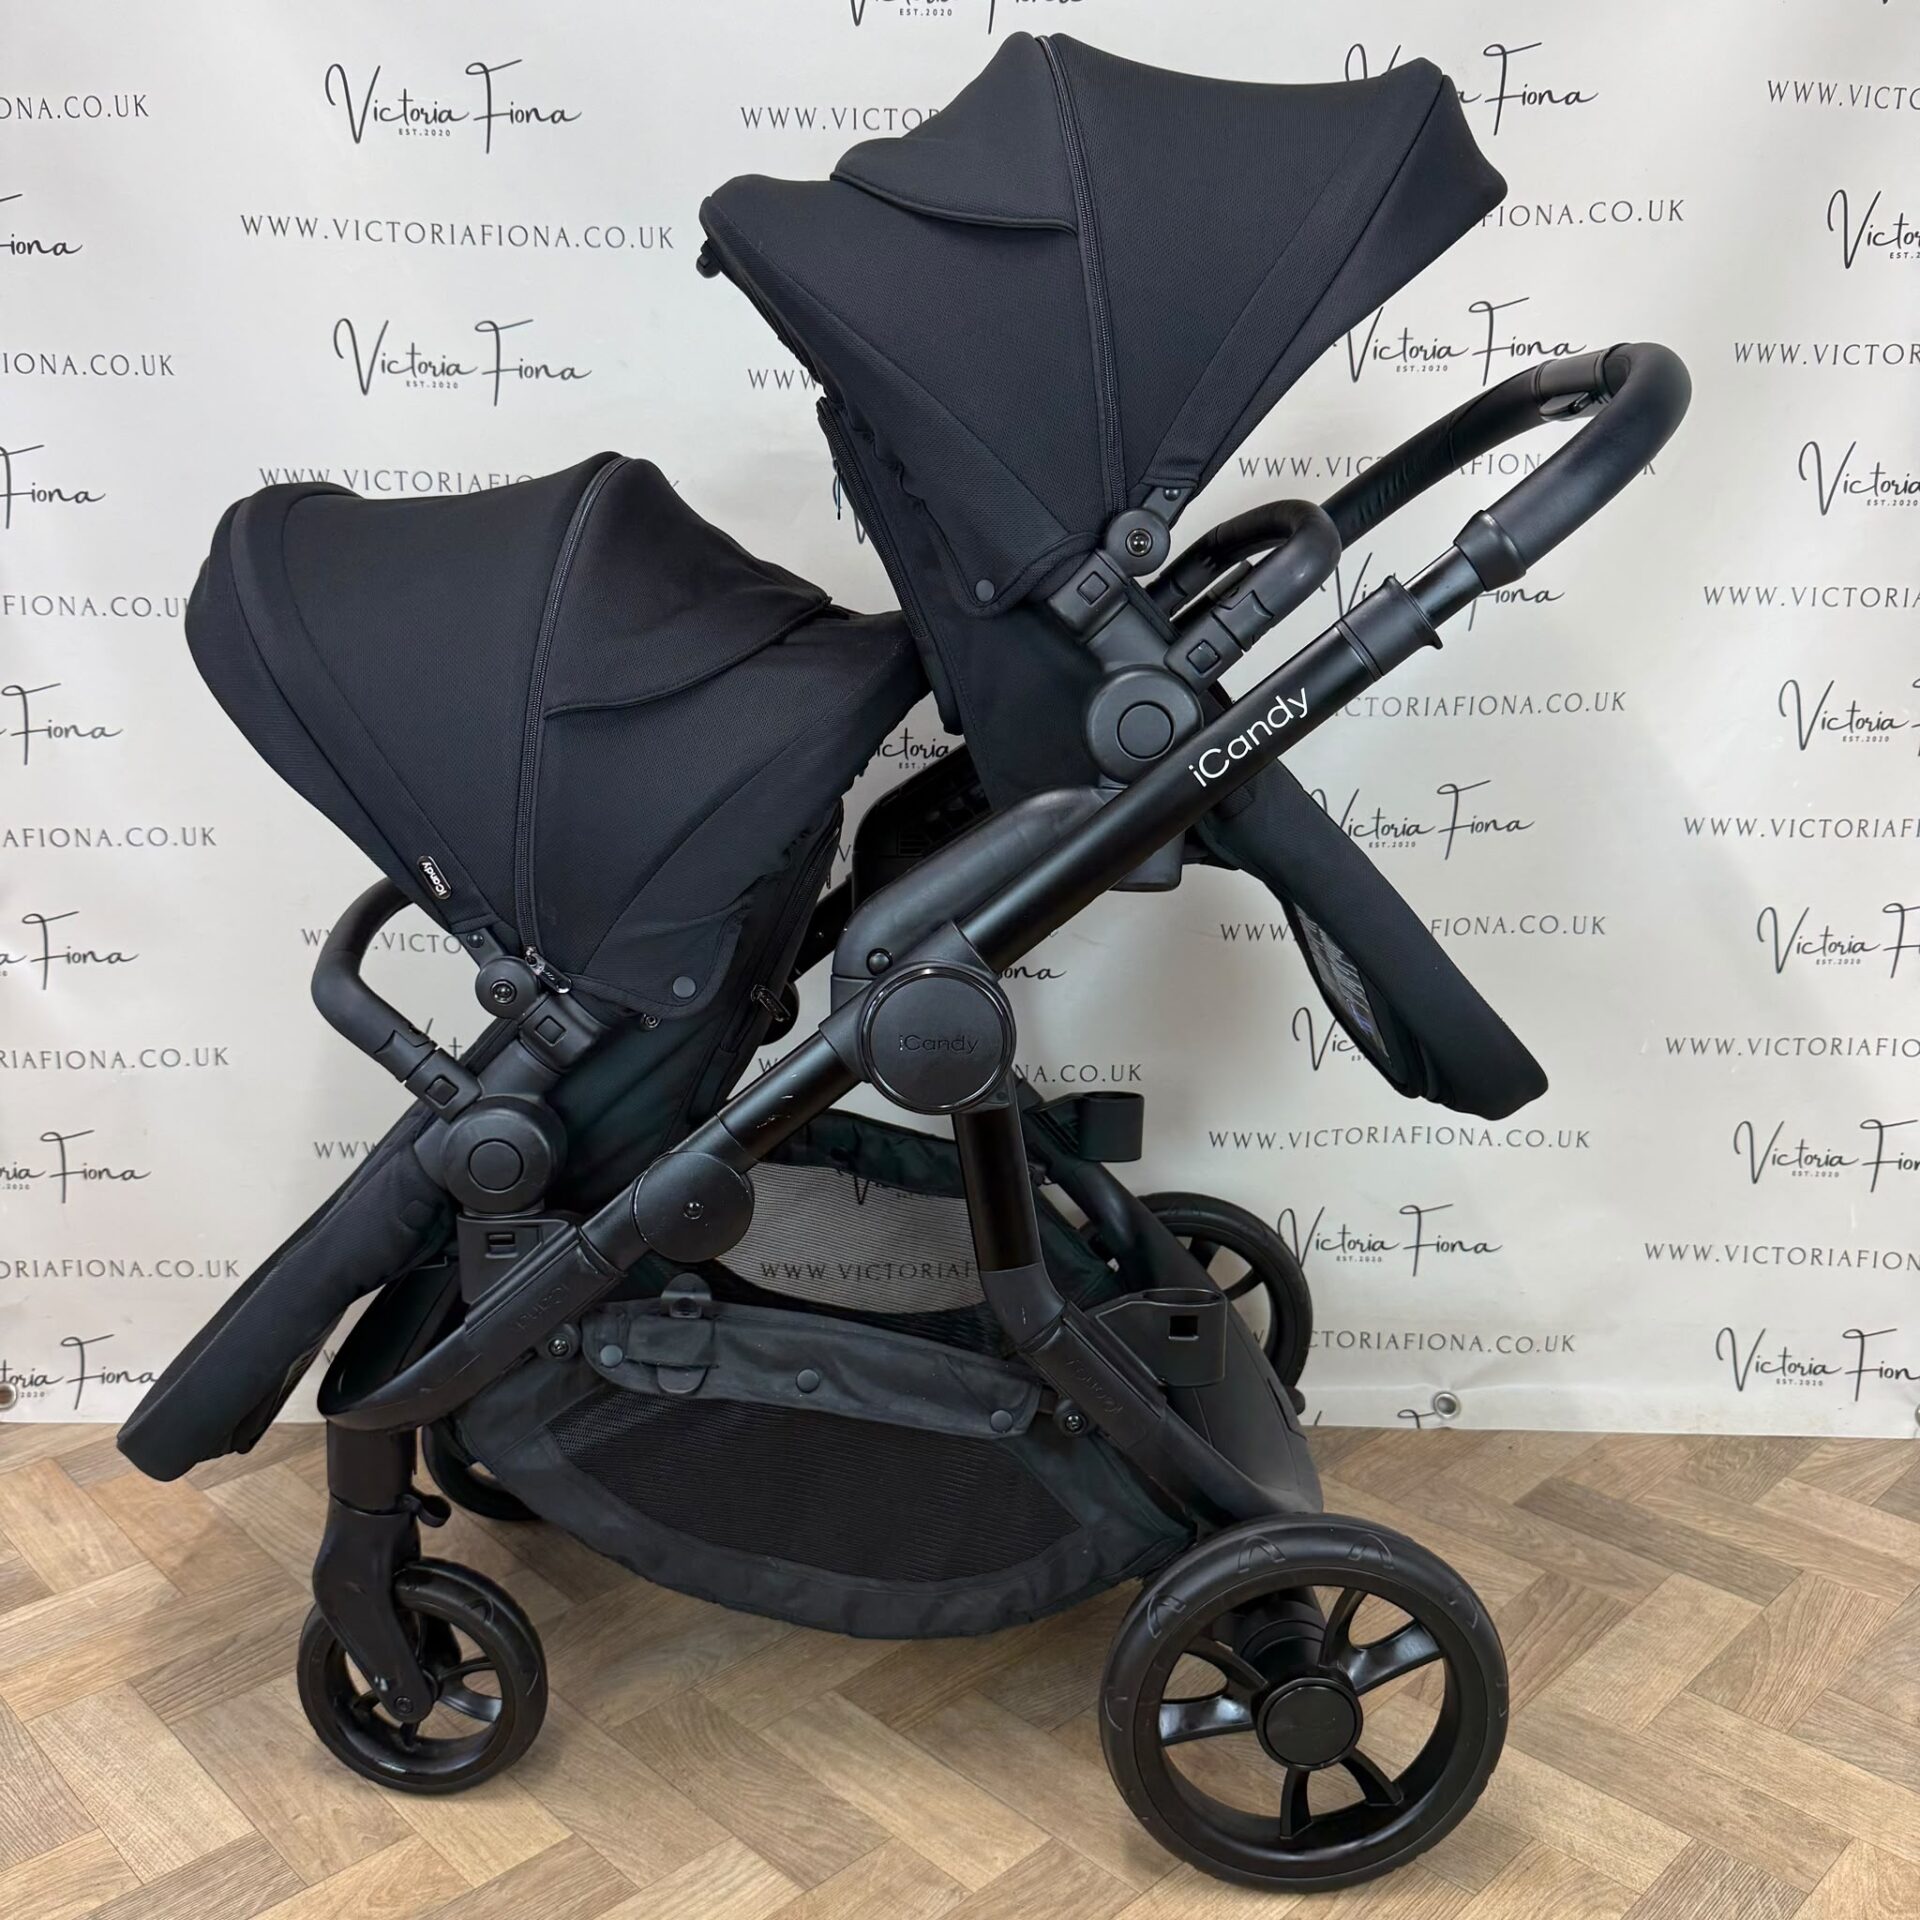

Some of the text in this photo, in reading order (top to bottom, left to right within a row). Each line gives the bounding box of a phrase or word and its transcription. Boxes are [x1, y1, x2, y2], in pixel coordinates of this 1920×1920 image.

[900, 8, 953, 17] EST.2020
[324, 59, 582, 154] Victoria Fiona
[1483, 42, 1599, 136] Fiona
[398, 128, 451, 137] EST.2020
[240, 214, 675, 250] WWW.VICTORIAFIONA.CO.UK
[333, 318, 592, 407] Victoria Fiona
[1396, 364, 1449, 374] EST.2020
[1469, 297, 1587, 387] Fiona
[406, 380, 459, 389] EST.2020
[3, 595, 190, 618] FIONA.CO.U
[1, 683, 123, 766] Fiona
[1188, 687, 1309, 788] iCandy
[1778, 679, 1909, 751] Victoria
[1437, 780, 1535, 860] Fiona
[22, 911, 139, 990] Fiona
[1757, 907, 1881, 974] Victoria
[900, 1034, 979, 1055] iCandy
[40, 1130, 151, 1204] Fiona
[1209, 1126, 1591, 1151] WWW.VICTORIAFIONA.CO.UK
[1733, 1121, 1859, 1184] Victoria
[1277, 1203, 1503, 1277] Victoria Fiona
[61, 1334, 157, 1411] Fiona
[1715, 1327, 1842, 1392] Victoria
